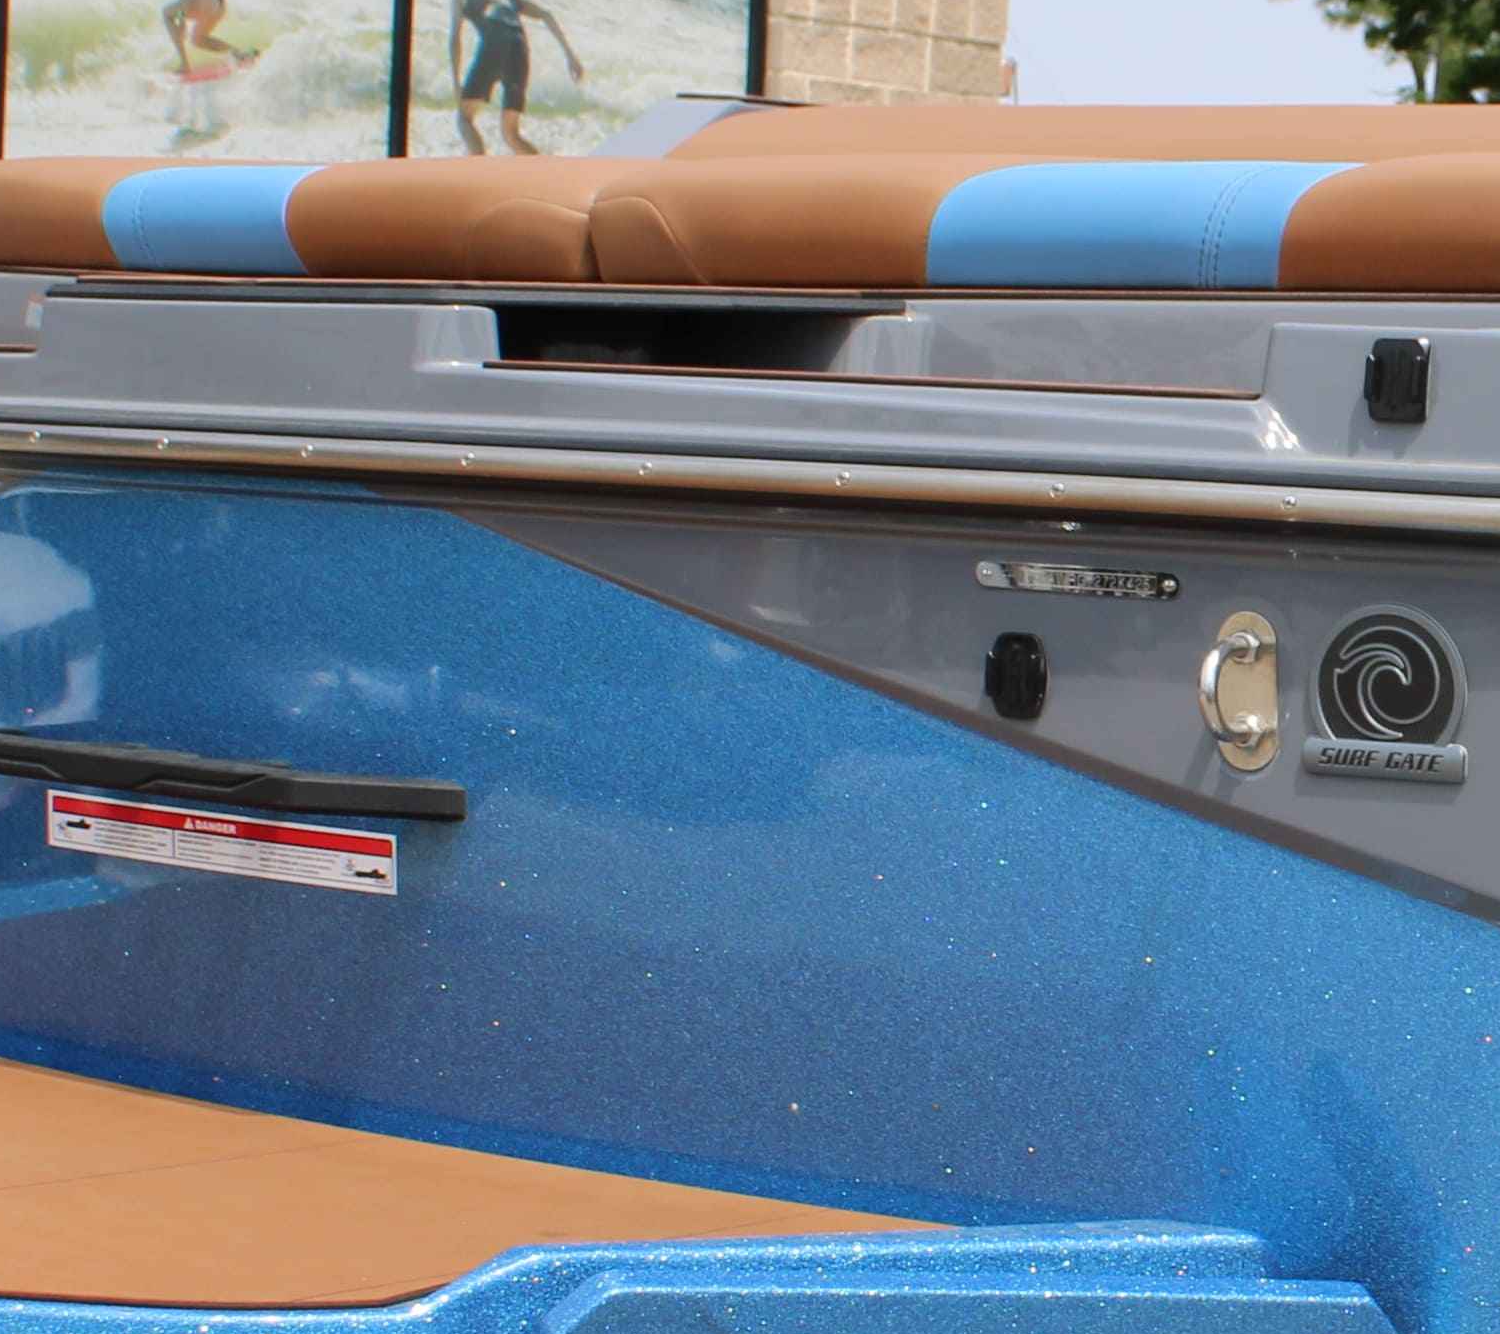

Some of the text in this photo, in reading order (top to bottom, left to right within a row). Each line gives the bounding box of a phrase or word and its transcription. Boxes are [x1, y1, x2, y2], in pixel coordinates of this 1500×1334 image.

[1317, 747, 1445, 772] SURF GATE
[195, 819, 237, 835] DANGER
